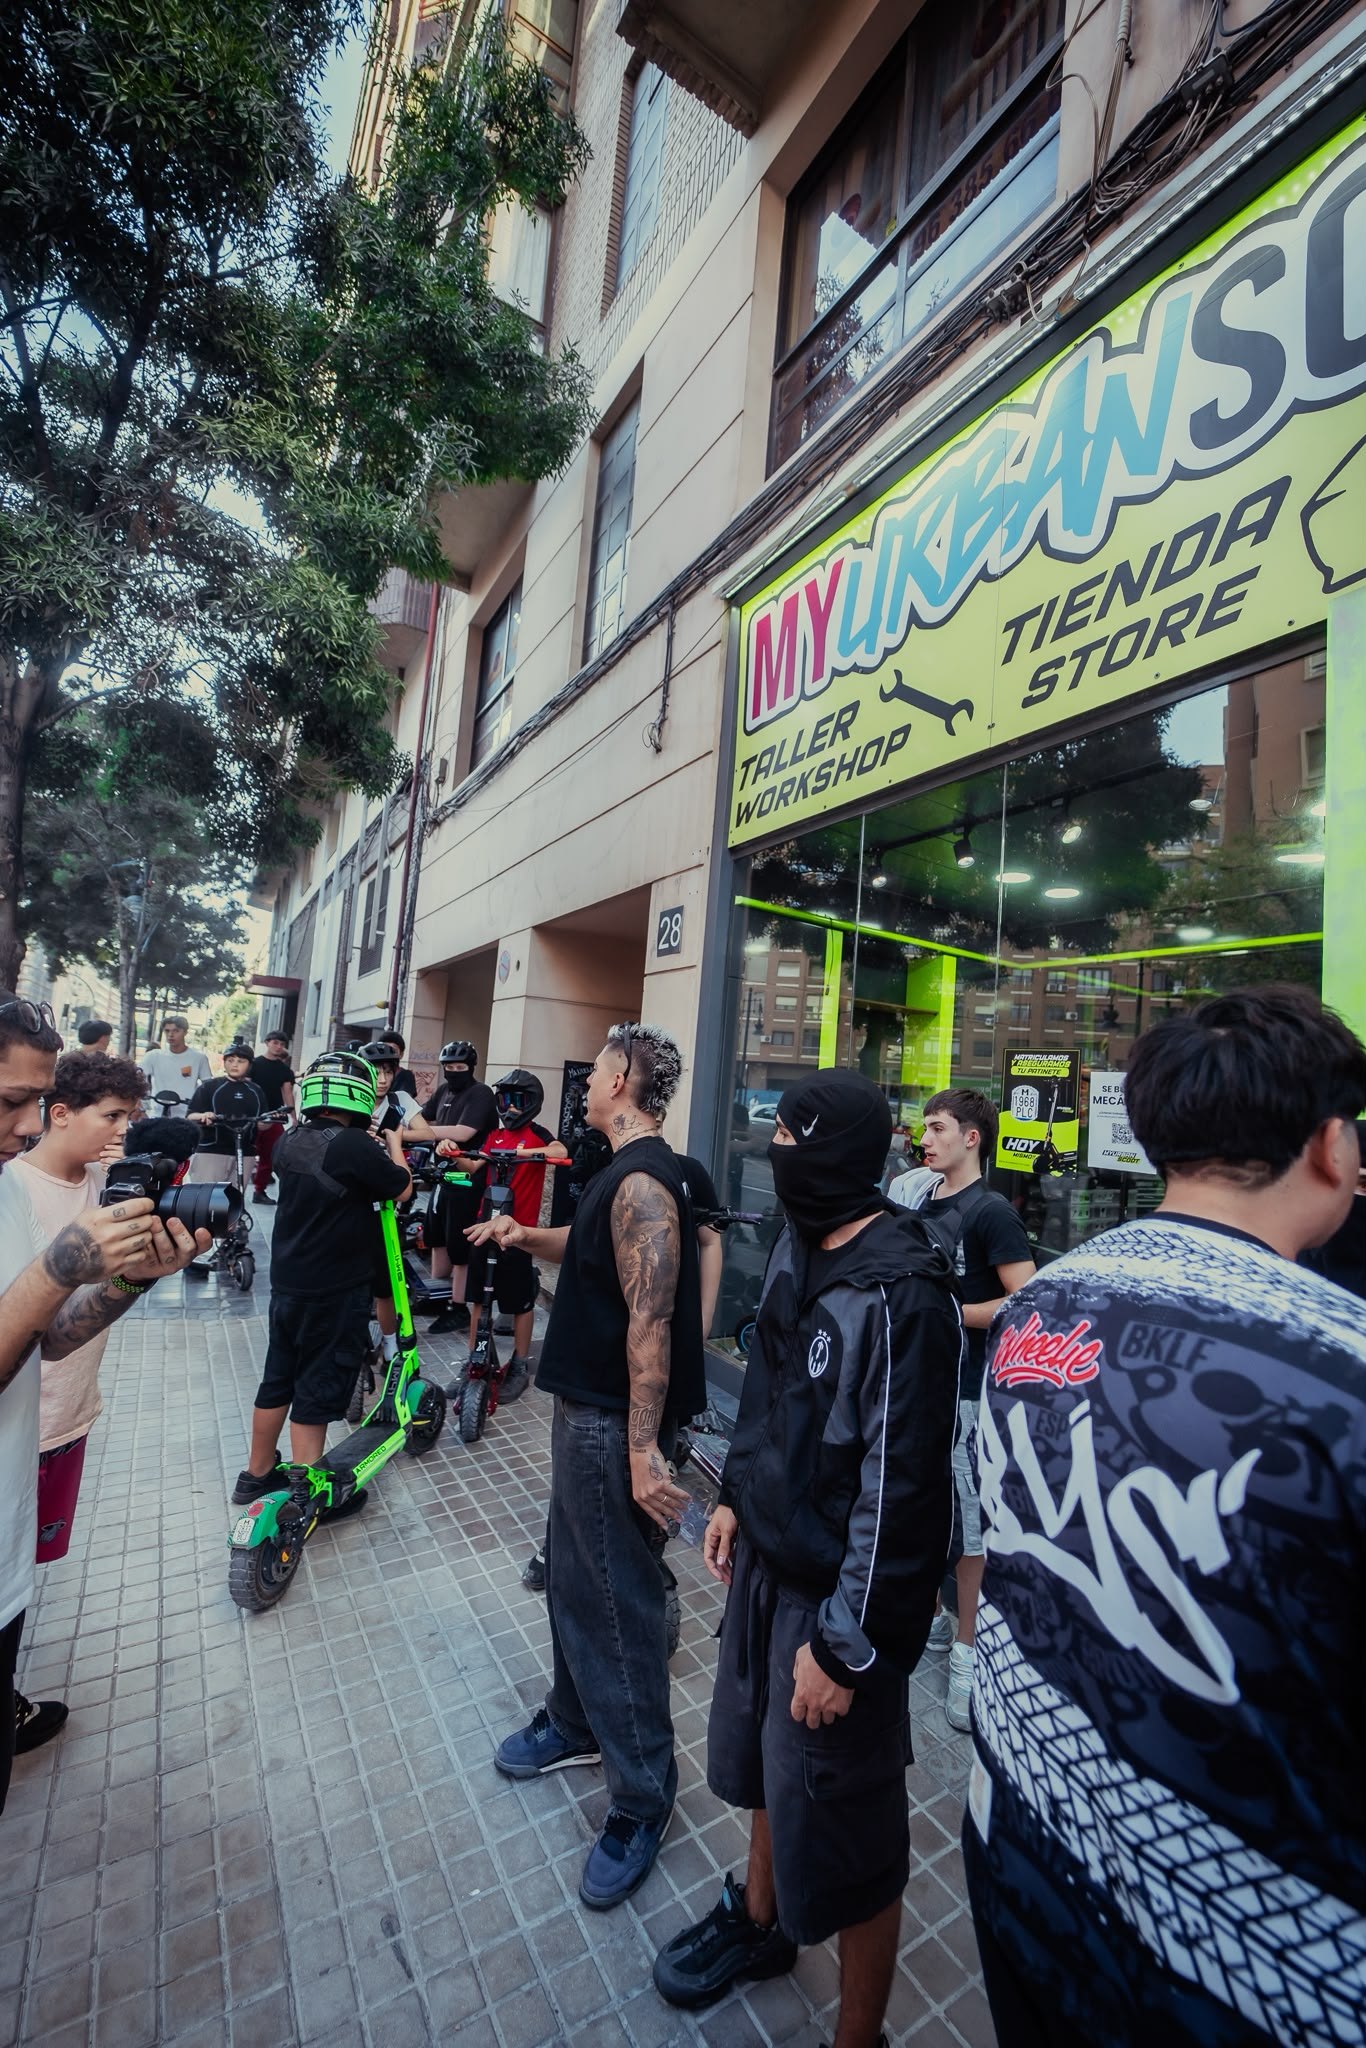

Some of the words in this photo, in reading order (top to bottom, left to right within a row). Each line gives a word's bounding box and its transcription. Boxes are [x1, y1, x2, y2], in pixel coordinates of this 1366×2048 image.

[1001, 475, 1292, 666] TIENDA
[1021, 564, 1262, 709] STORE
[739, 700, 860, 791] TALLER
[735, 723, 911, 828] WORKSHOP
[658, 913, 682, 950] 28
[1017, 1060, 1071, 1068] ASEGURAMOS
[1014, 1096, 1035, 1108] 1968
[1016, 1107, 1033, 1118] PLC
[1092, 1094, 1127, 1106] MECÁ
[1005, 1137, 1041, 1152] HOY
[355, 1445, 387, 1475] ARMORED
